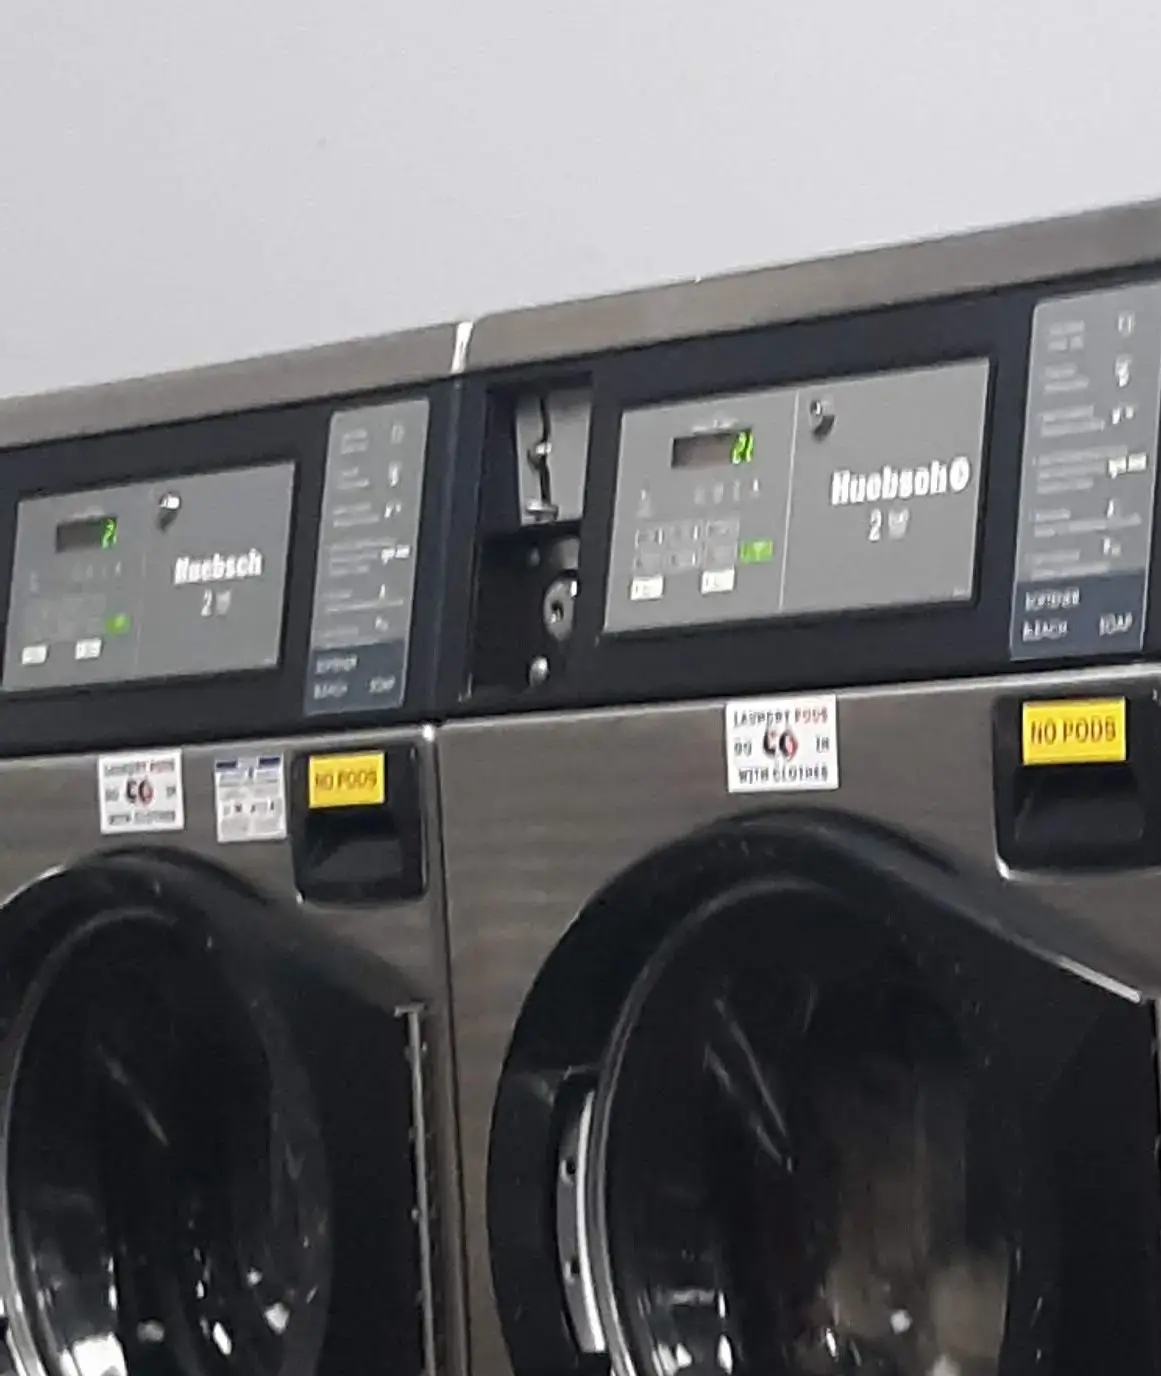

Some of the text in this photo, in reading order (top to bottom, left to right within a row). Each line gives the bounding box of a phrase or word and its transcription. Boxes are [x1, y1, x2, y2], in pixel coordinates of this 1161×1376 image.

[831, 459, 947, 506] Huebsch
[867, 507, 883, 542] 2
[174, 547, 263, 585] Huebsch
[1030, 715, 1117, 745] NO PODS
[315, 773, 334, 791] NO
